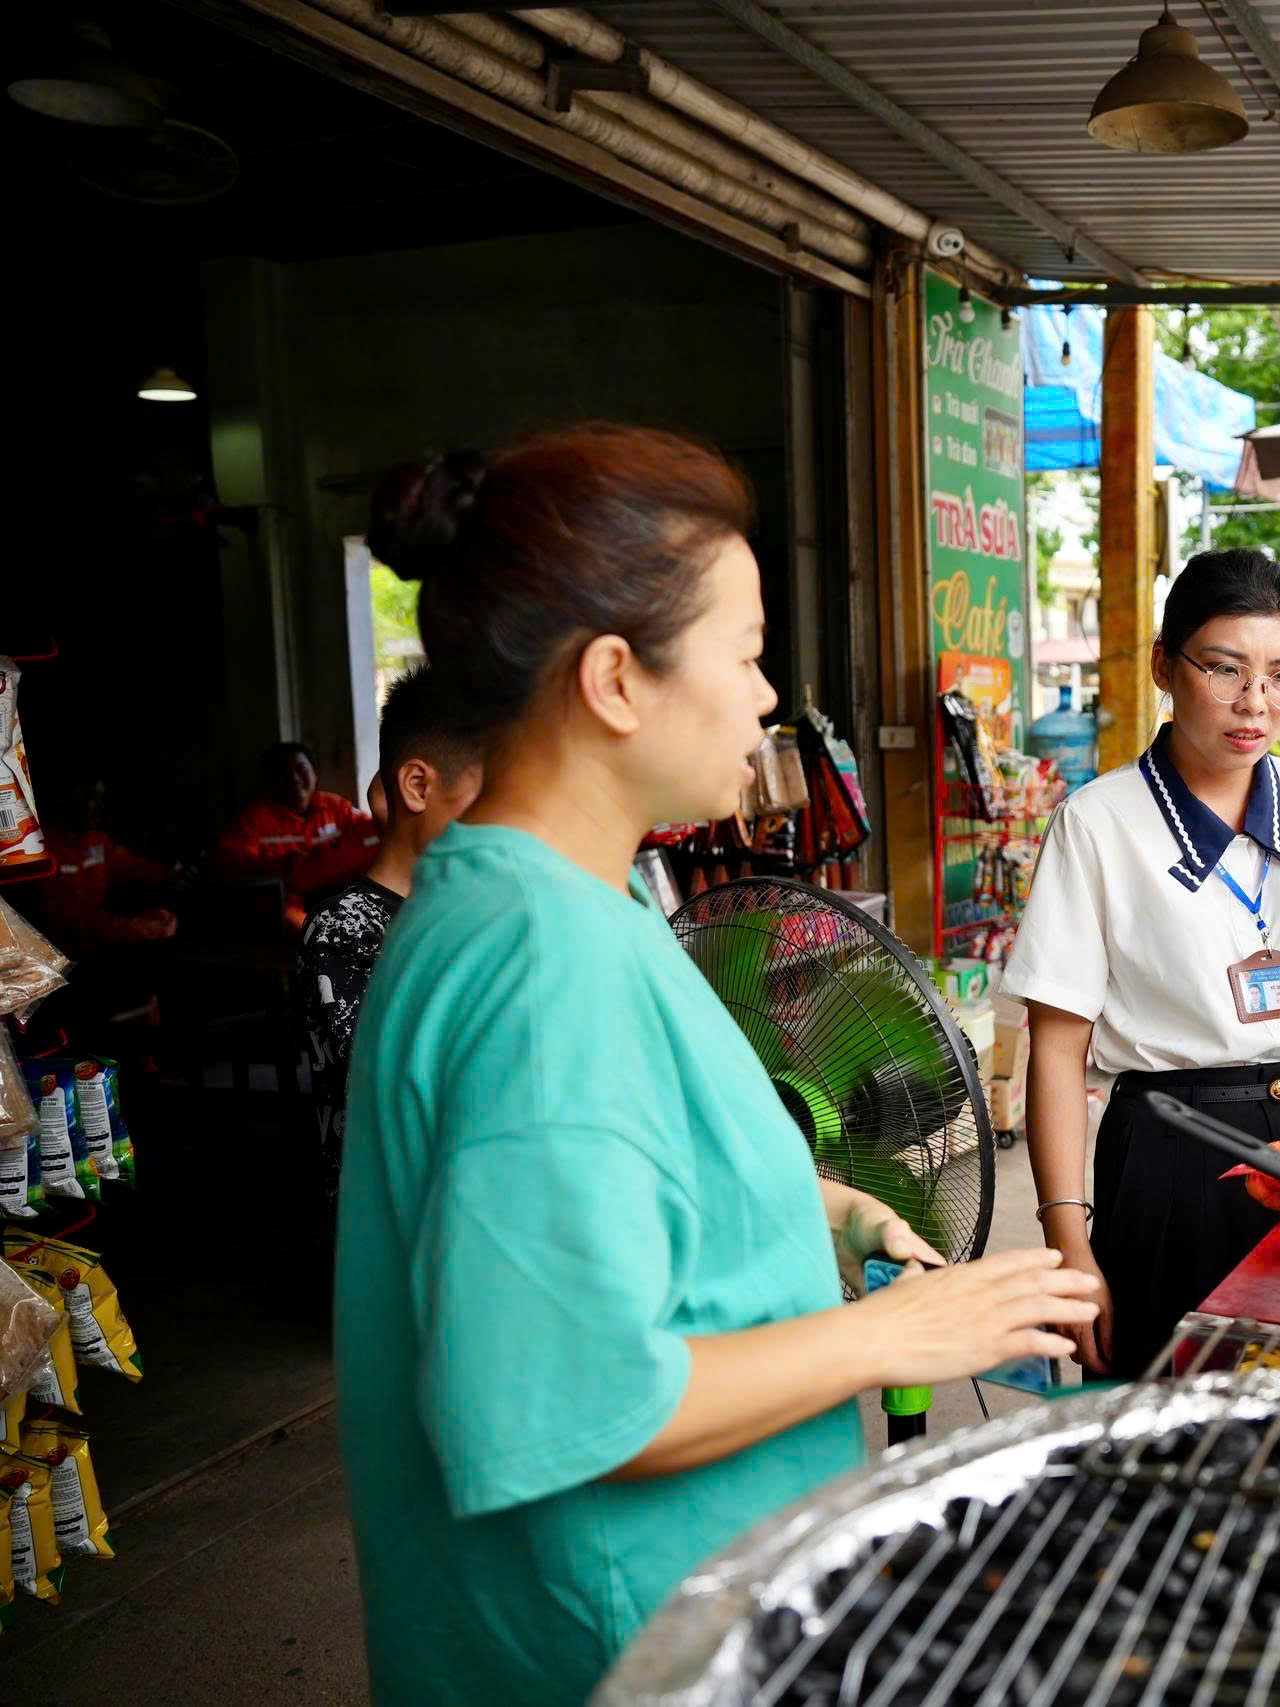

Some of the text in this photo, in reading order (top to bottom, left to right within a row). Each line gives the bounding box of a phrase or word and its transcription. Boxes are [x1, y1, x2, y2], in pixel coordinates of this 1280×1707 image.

[932, 483, 1022, 562] TRÀ SỮA
[932, 570, 1008, 656] Café
